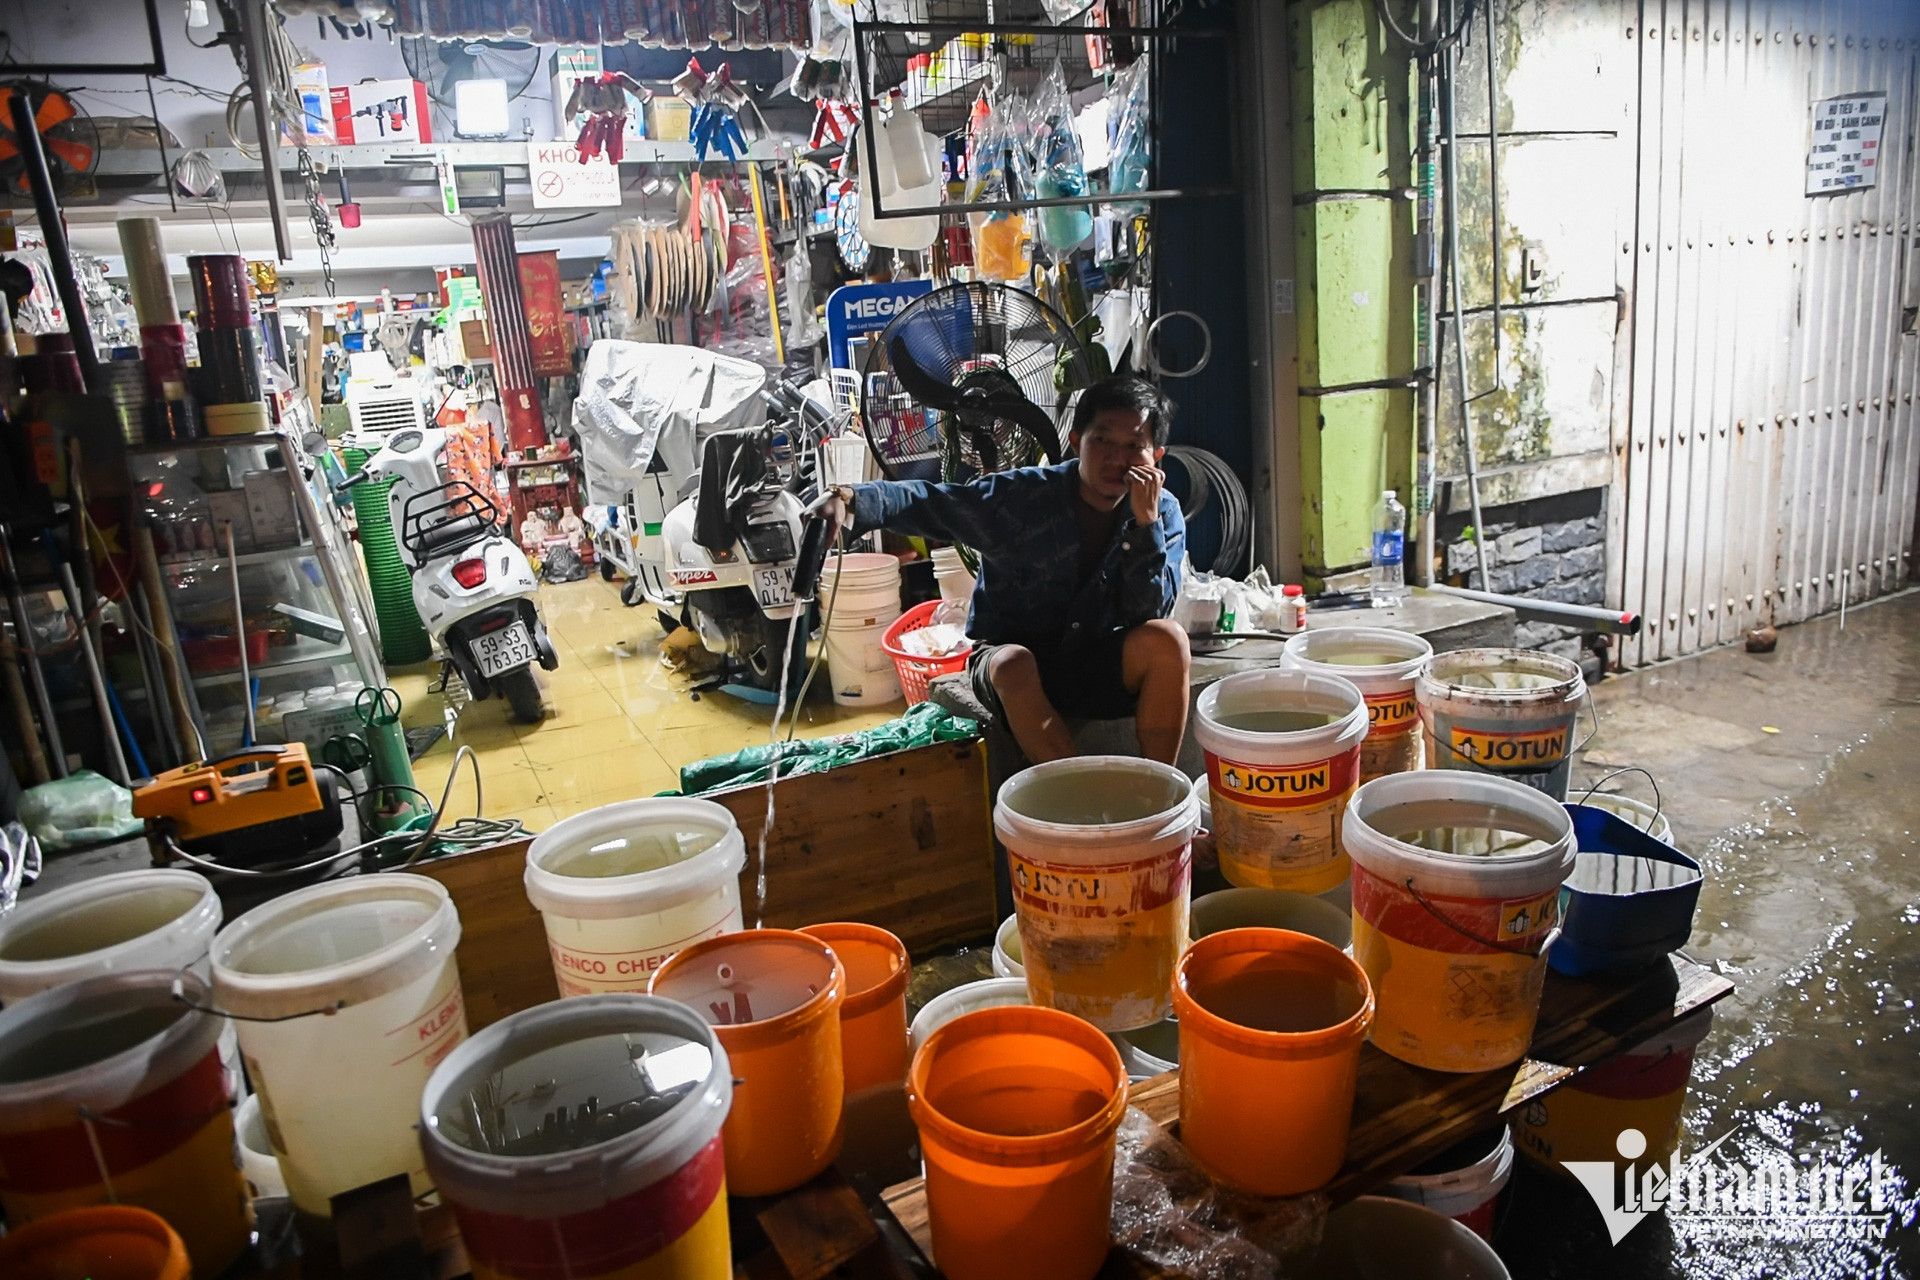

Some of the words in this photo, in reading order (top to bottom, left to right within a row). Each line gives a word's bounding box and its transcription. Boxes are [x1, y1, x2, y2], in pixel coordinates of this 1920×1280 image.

[480, 628, 521, 655] 59-S3
[483, 643, 533, 674] 763.52
[1368, 701, 1416, 721] OTUN
[1483, 734, 1564, 760] JOTUN
[1245, 770, 1325, 793] JOTUN
